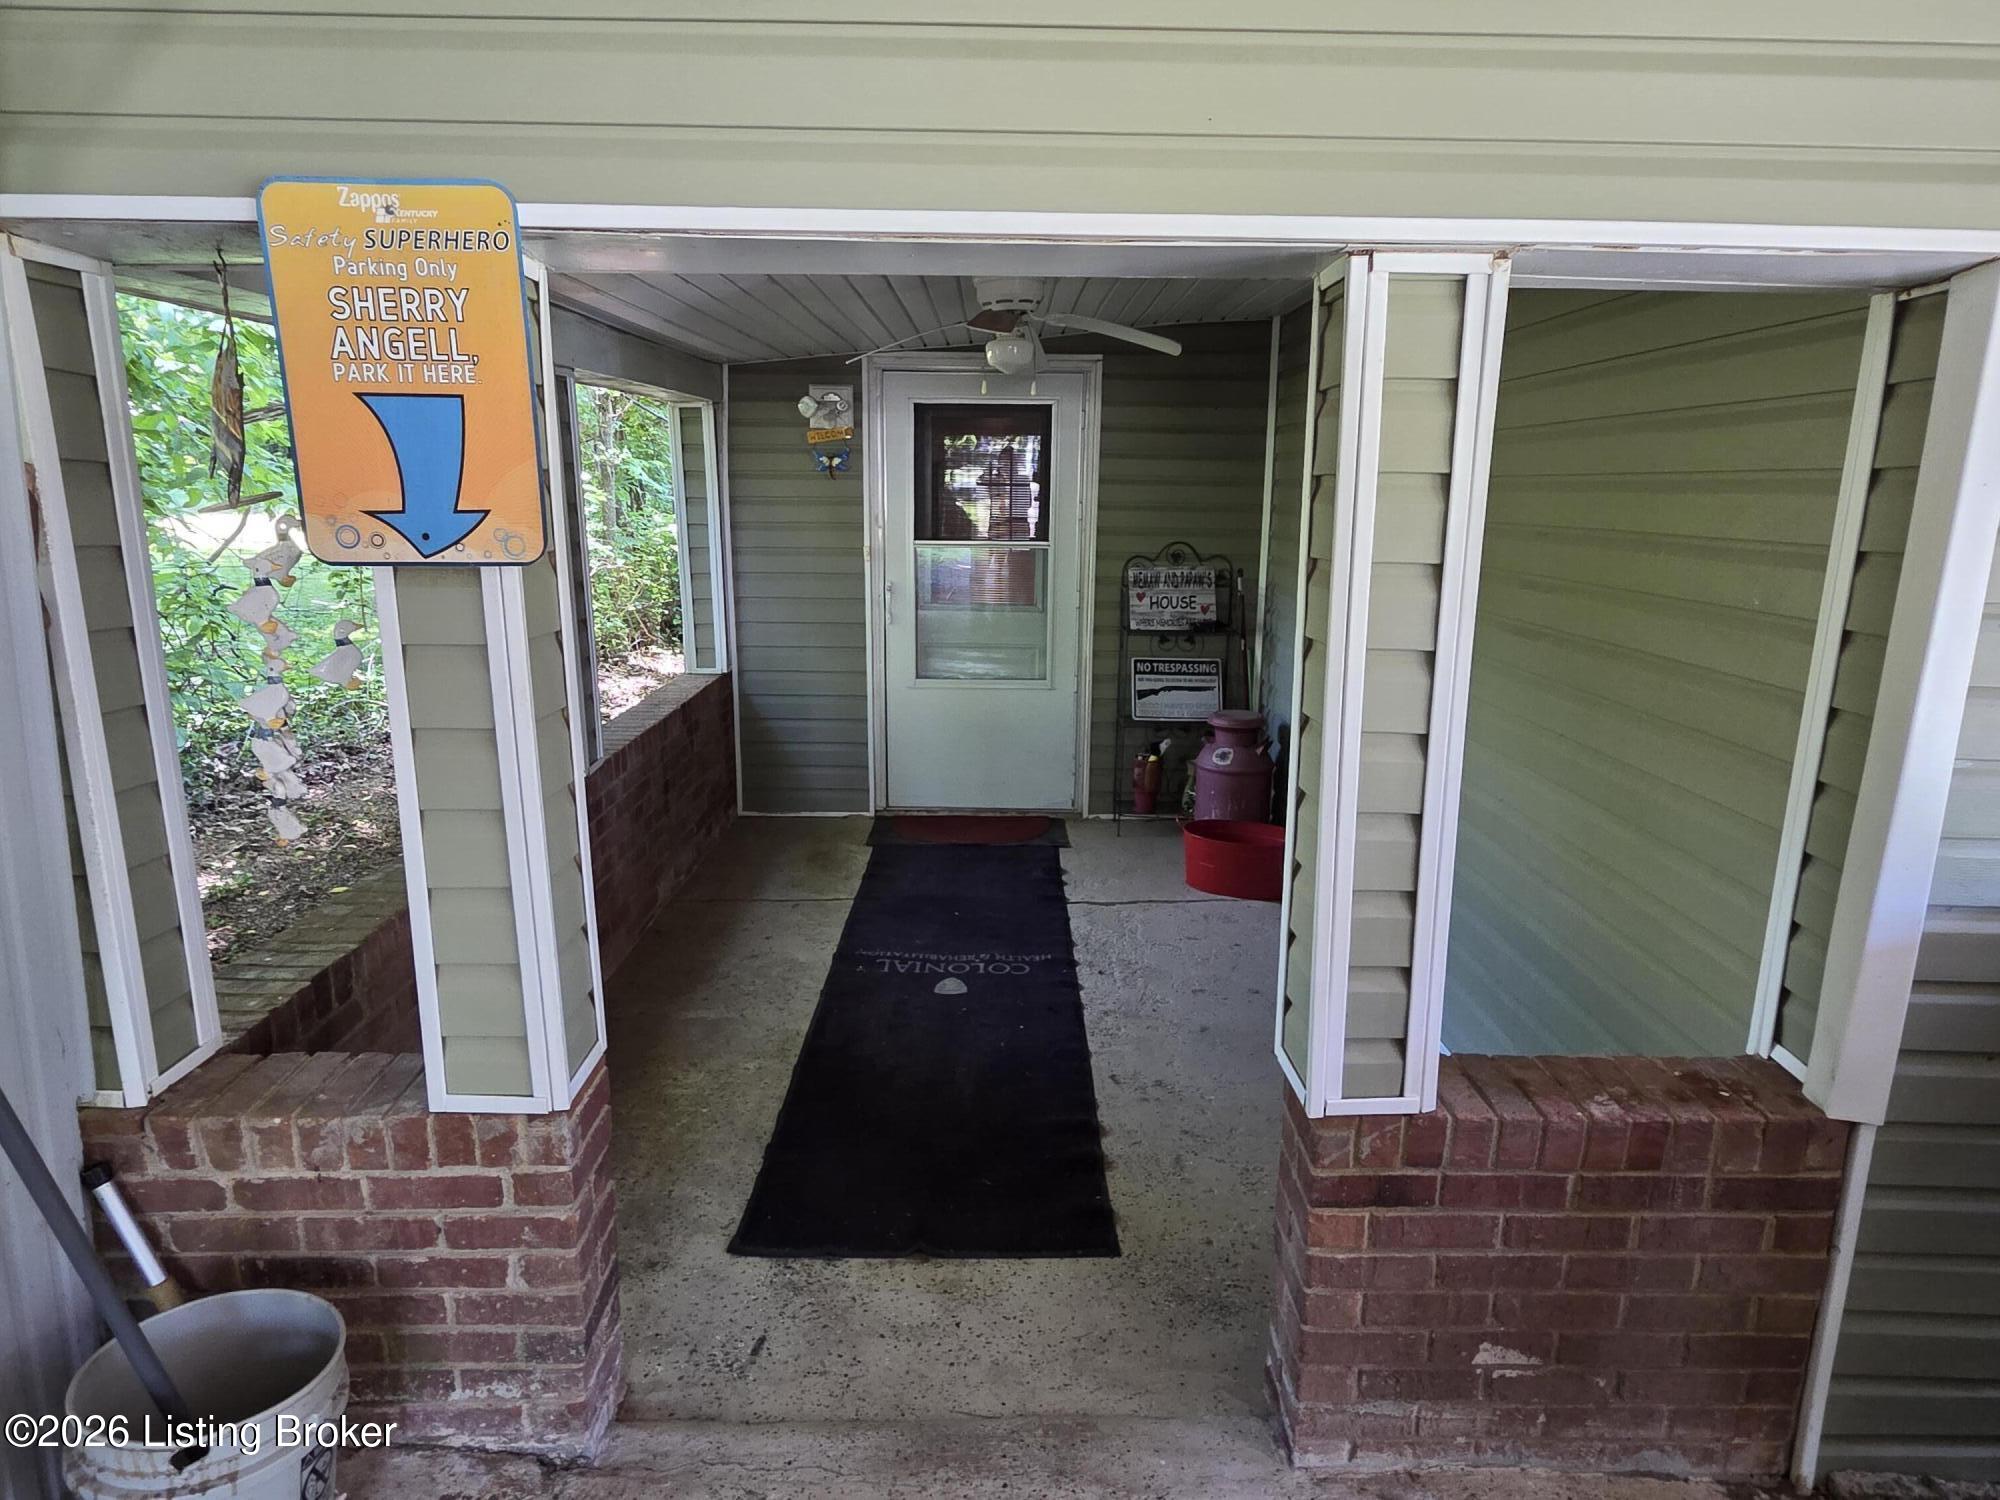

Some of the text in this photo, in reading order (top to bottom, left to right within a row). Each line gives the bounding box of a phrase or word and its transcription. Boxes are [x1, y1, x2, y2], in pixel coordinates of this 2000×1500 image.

[337, 186, 400, 212] Zappos
[269, 224, 511, 258] Safety SUPERHERO
[332, 255, 458, 282] Parking Only
[327, 285, 470, 323] SHERRY
[330, 326, 480, 367] ANGELL,
[332, 363, 484, 386] PARK IT HERE.
[1149, 595, 1197, 610] HOUSE
[1136, 662, 1217, 674] NO TRESPASSING
[876, 959, 1030, 975] COLONIAL
[994, 952, 1052, 962] HEALTH
